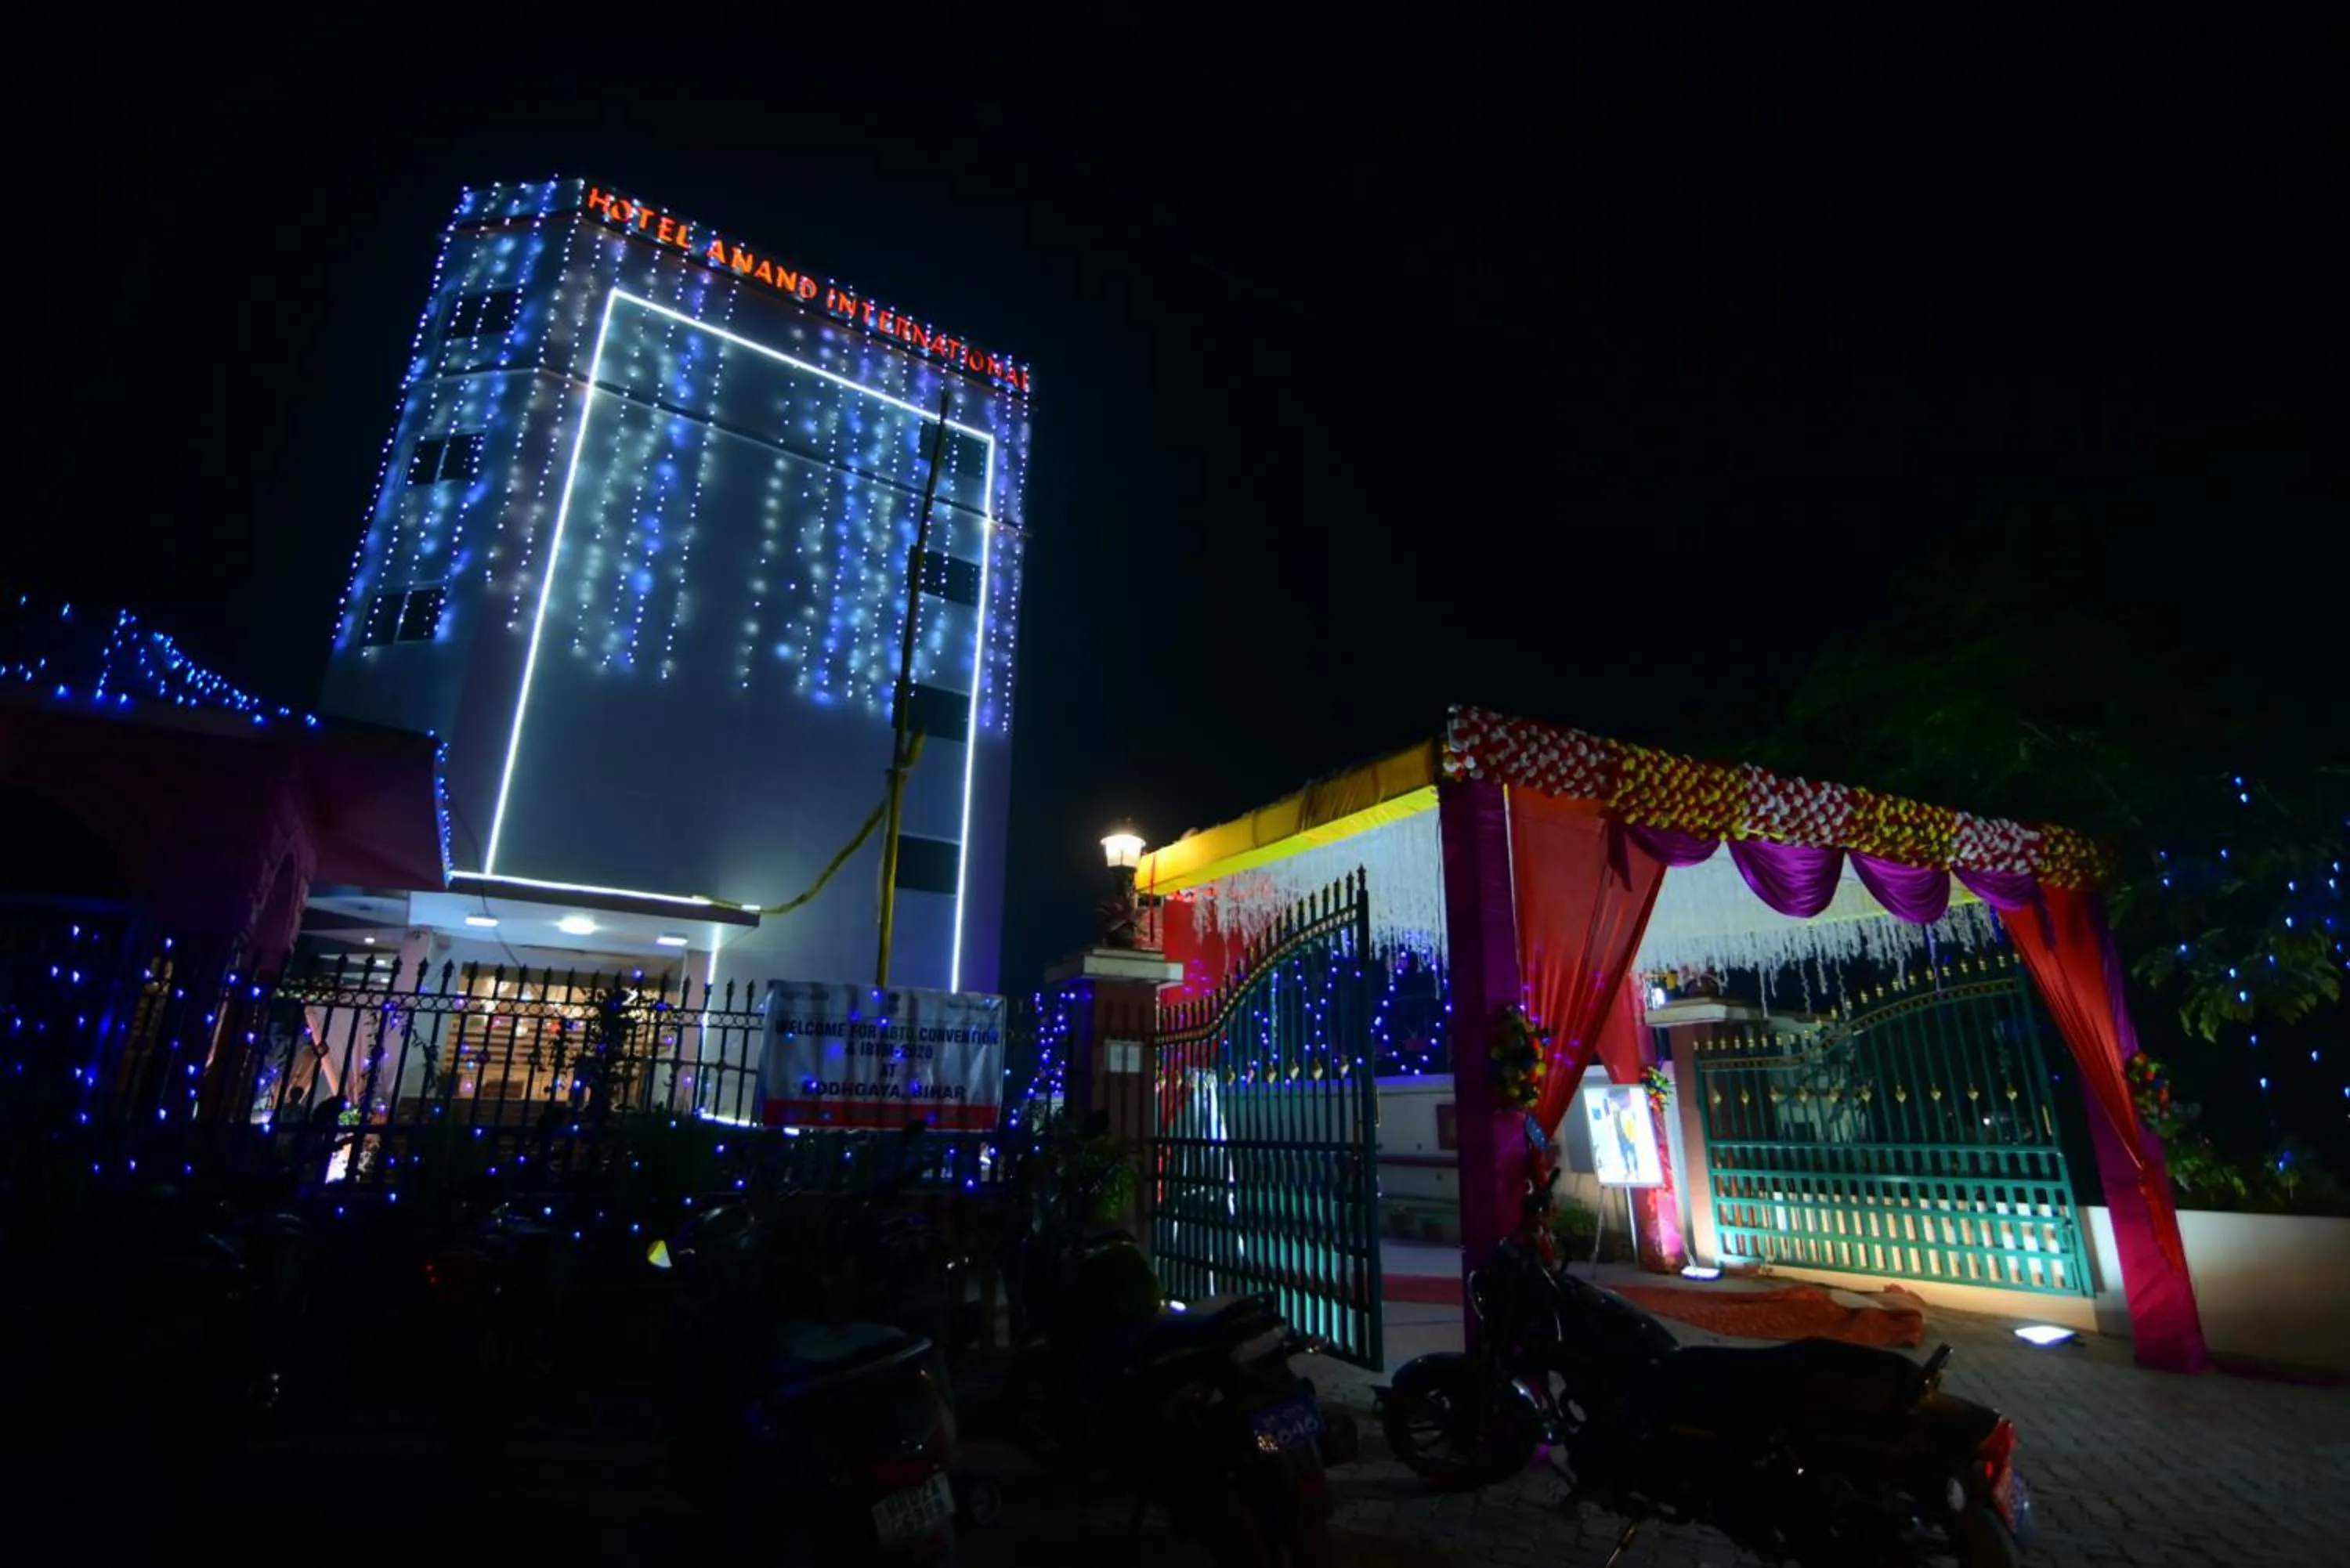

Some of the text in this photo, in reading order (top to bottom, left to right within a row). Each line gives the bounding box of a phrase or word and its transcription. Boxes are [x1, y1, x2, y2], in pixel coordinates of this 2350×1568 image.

[588, 187, 1032, 393] HOTEL ANAND INTERNATIONAL
[776, 1019, 844, 1038] WELCOME
[851, 1024, 877, 1039] FOR
[919, 1027, 1000, 1046] CONVENTION
[880, 1063, 897, 1078] AT
[913, 1083, 967, 1100] BIHAR
